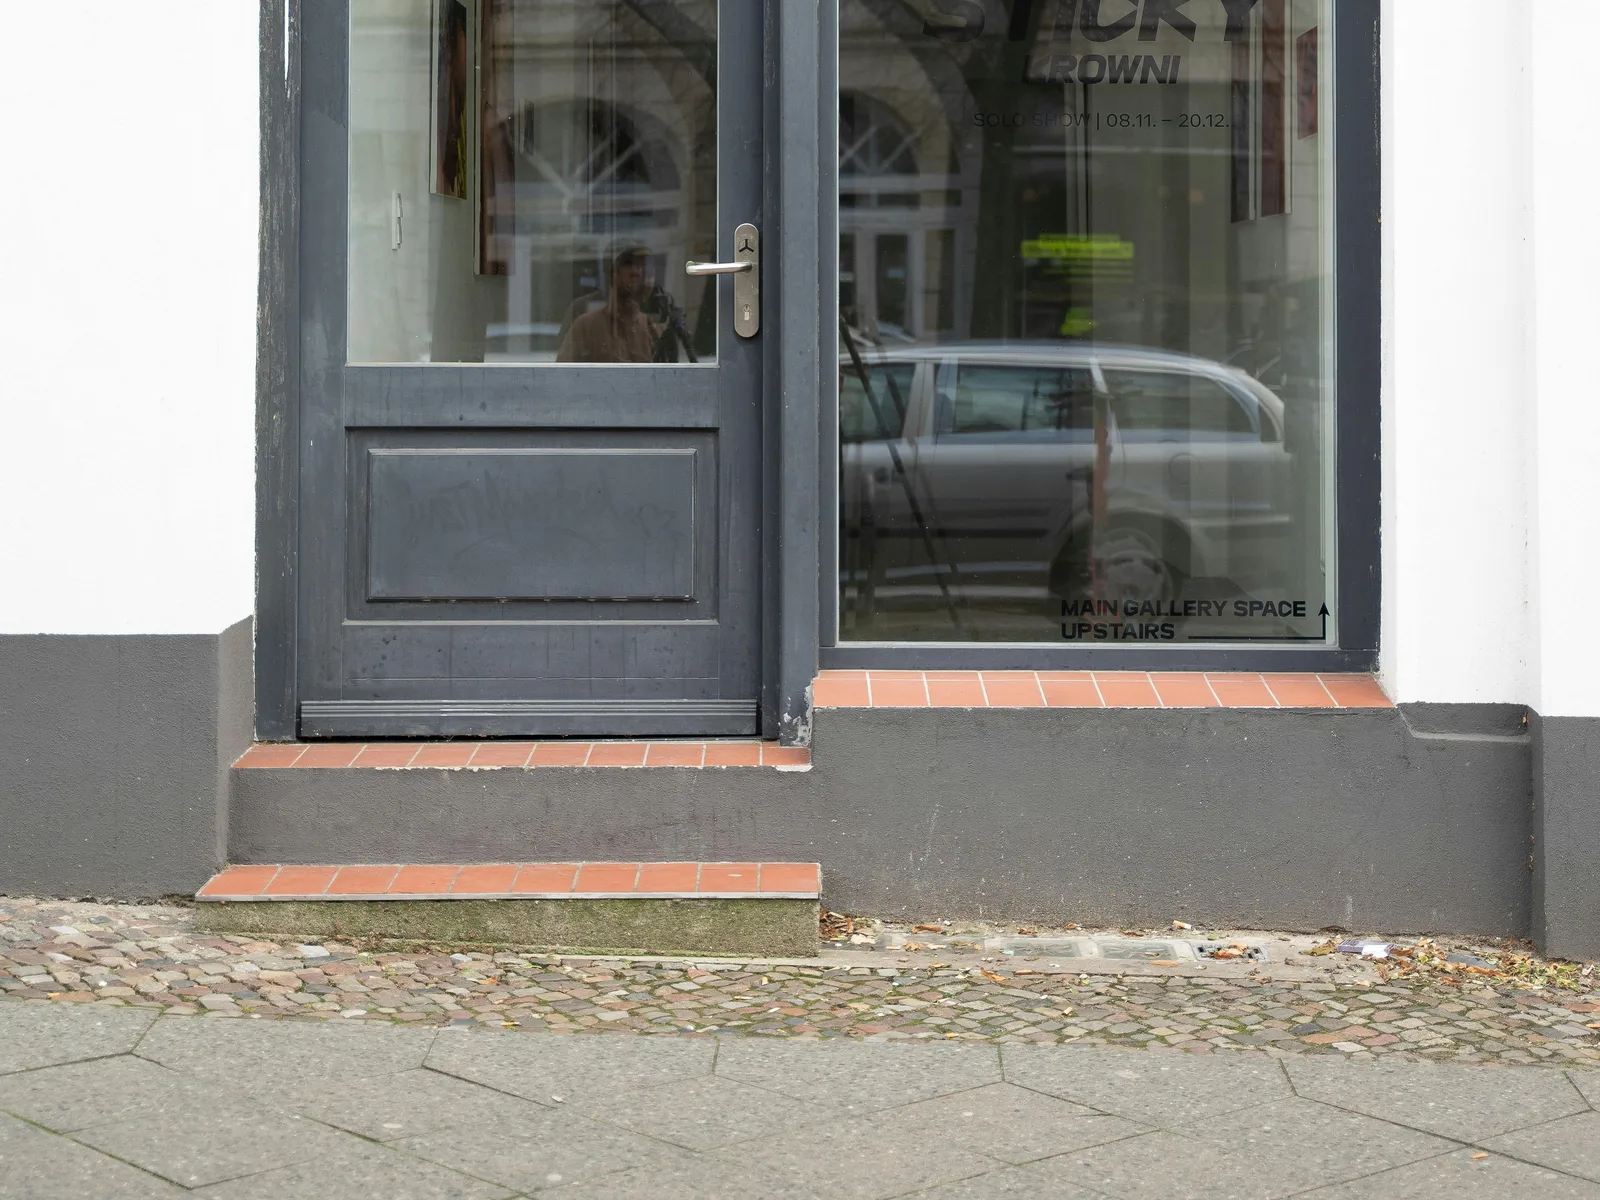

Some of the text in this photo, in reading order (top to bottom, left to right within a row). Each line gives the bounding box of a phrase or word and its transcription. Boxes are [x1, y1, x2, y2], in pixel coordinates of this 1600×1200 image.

[973, 112, 1026, 128] SOLO
[1031, 112, 1091, 128] SHOW
[1106, 113, 1156, 128] 08.11.
[1178, 113, 1230, 128] 20.12.
[1061, 600, 1306, 617] MAIN GALLERY SPACE
[1061, 623, 1175, 640] UPSTAIRS
